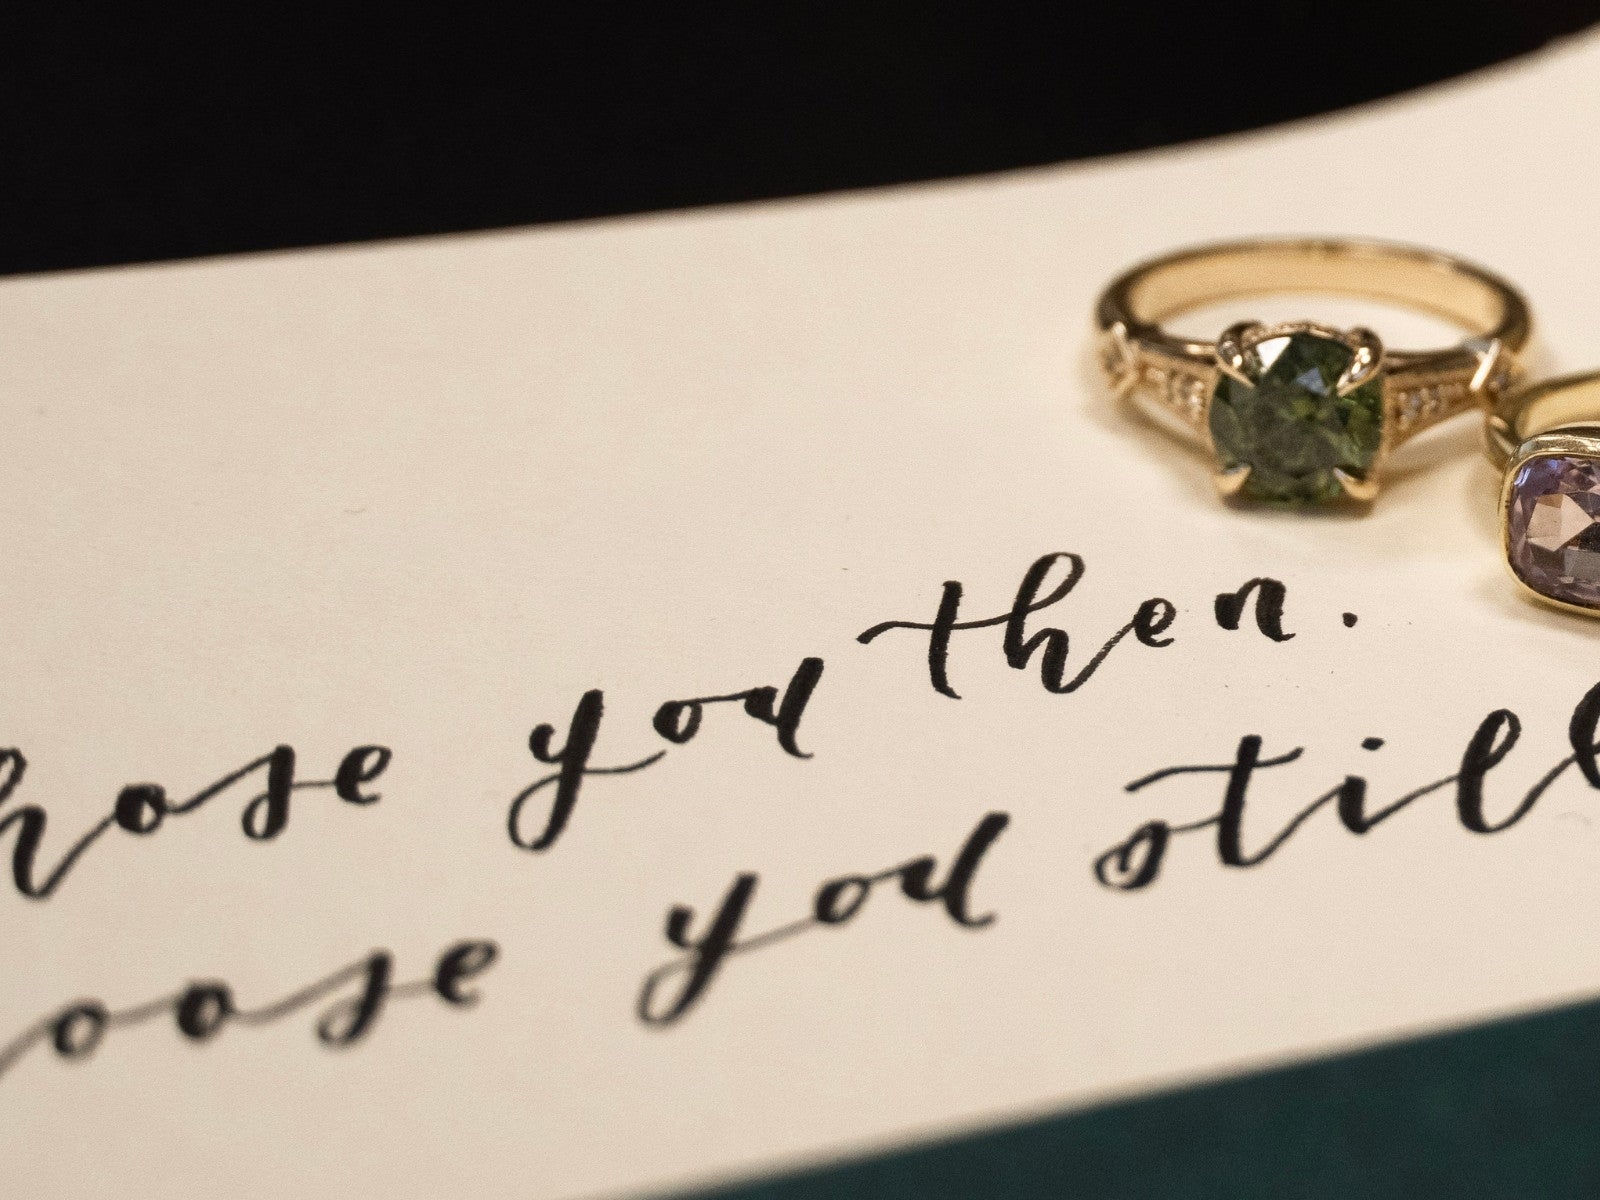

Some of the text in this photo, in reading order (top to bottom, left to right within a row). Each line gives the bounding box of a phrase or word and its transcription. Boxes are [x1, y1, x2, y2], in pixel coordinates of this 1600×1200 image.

[507, 656, 826, 853] you
[856, 551, 1358, 701] then.
[637, 811, 1011, 1027] you
